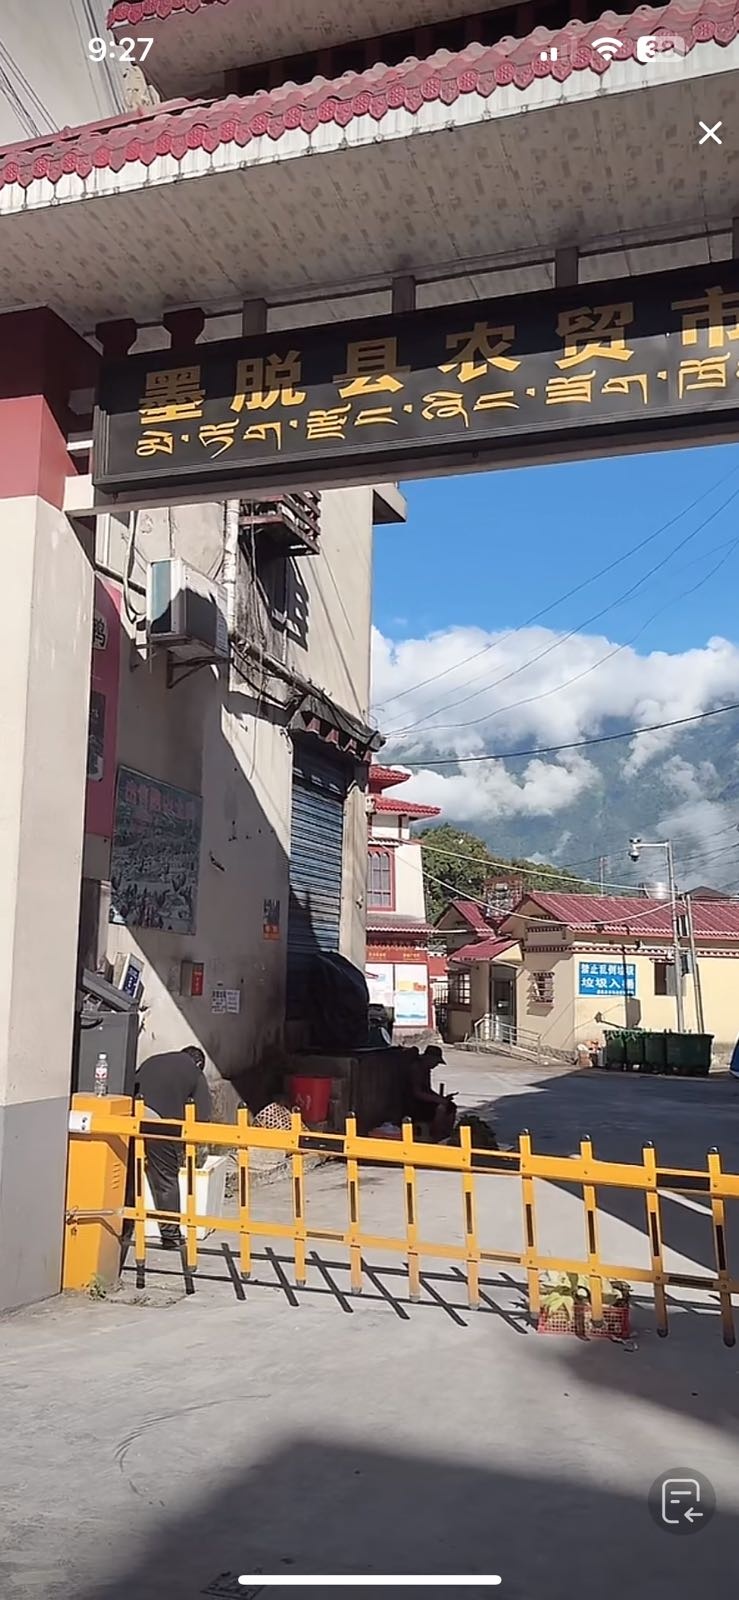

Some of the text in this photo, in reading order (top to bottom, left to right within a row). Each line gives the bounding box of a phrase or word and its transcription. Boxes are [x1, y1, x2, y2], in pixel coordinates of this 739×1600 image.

[138, 285, 739, 426] 墨脱县农贸市
